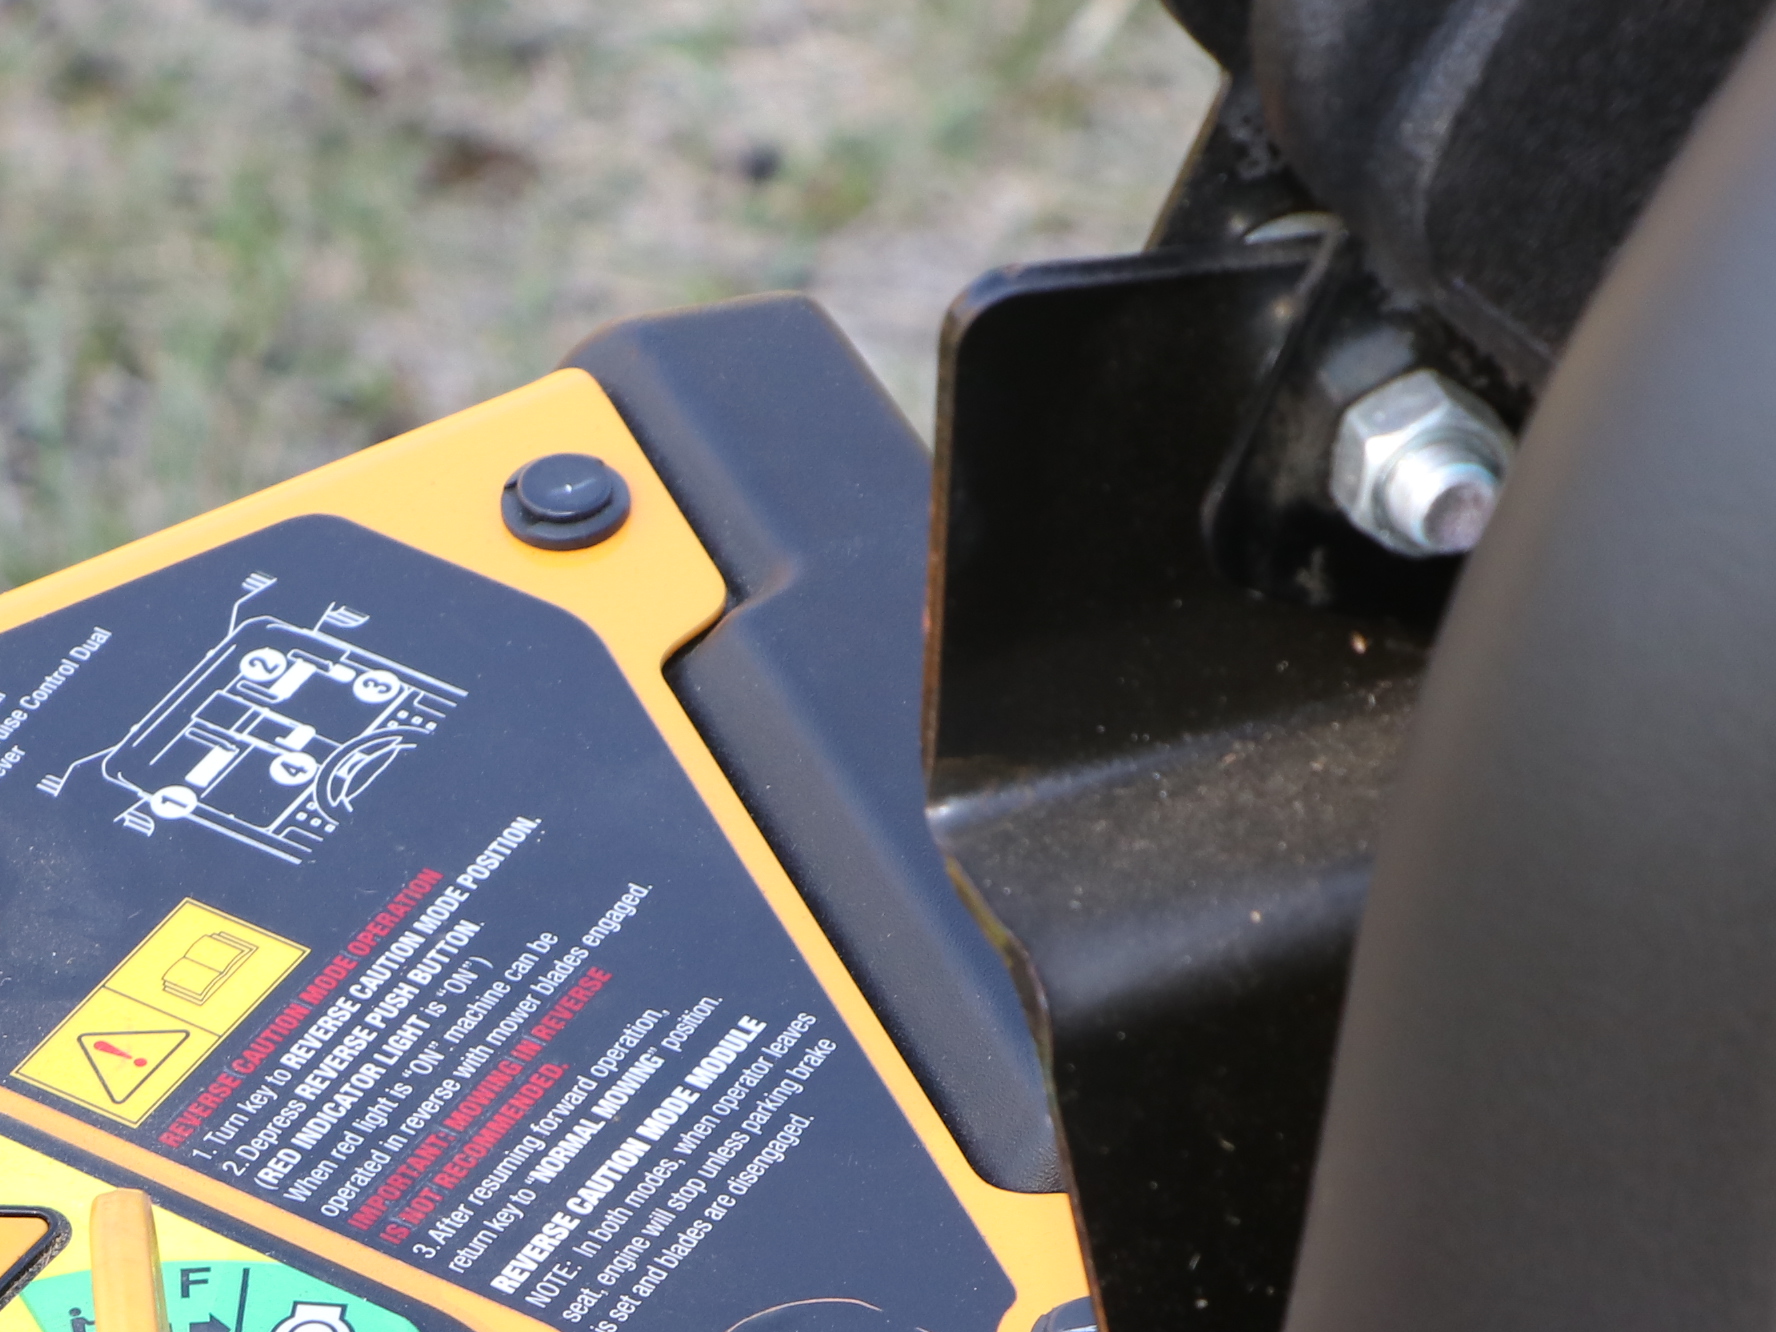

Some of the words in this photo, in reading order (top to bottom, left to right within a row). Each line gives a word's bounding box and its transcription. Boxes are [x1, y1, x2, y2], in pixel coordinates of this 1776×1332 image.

[18, 657, 81, 712] Control
[68, 625, 113, 663] Dual
[157, 1072, 243, 1149] REVERSE
[230, 1002, 312, 1075] CAUTION
[298, 954, 359, 1006] MODE
[346, 867, 444, 957] OPERATION
[201, 1112, 251, 1146] Turn
[235, 1083, 279, 1115] key
[263, 1067, 293, 1087] to
[278, 995, 363, 1071] REVERSE
[348, 930, 427, 1000] CAUTION
[411, 885, 471, 936] MODE
[455, 815, 543, 891] POSITION.
[281, 1159, 340, 1203] When
[329, 1129, 366, 1161] red
[350, 1096, 400, 1134] light
[383, 1081, 414, 1100] is
[442, 980, 512, 1045] machine
[503, 951, 541, 982] can
[525, 931, 559, 955] be
[293, 1024, 379, 1102] REVERSE
[363, 981, 421, 1030] PUSH
[405, 918, 486, 986] BUTTON.
[319, 1147, 393, 1218] operated
[377, 1133, 409, 1153] in
[398, 1077, 462, 1136] reverse
[451, 1043, 495, 1080] with
[484, 992, 542, 1047] mower
[528, 945, 590, 997] blades
[580, 881, 654, 948] engaged.
[760, 1011, 818, 1059] leaves
[252, 1147, 303, 1191] (RED
[289, 1061, 388, 1151] INDICATOR
[372, 1013, 432, 1067] LIGHT
[418, 1000, 448, 1019] is
[347, 1130, 456, 1231] IMPORTANT:
[442, 1059, 524, 1132] MOWING
[510, 1038, 543, 1062] IN
[529, 966, 613, 1042] REVERSE
[378, 1222, 411, 1246] IS
[397, 1186, 444, 1226] NOT
[432, 1062, 570, 1190] RECOMMENDED.
[447, 1228, 499, 1275] return
[482, 1201, 525, 1233] key
[508, 1187, 538, 1206] to
[659, 996, 724, 1053] position.
[466, 1134, 548, 1207] resuming
[528, 1074, 599, 1137] forward
[589, 1008, 671, 1079] operation,
[489, 1210, 582, 1295] REVERSE
[565, 1136, 652, 1216] CAUTION
[634, 1084, 702, 1142] MODE
[683, 1014, 768, 1091] MODULE
[672, 1114, 722, 1156] when
[711, 1054, 775, 1117] operator
[561, 1286, 610, 1324] seat,
[596, 1235, 652, 1287] engine
[640, 1206, 677, 1238] will
[666, 1177, 709, 1212] stop
[696, 1130, 752, 1180] unless
[740, 1077, 805, 1136] parking
[784, 1037, 838, 1081] brake
[571, 1239, 603, 1259] In
[586, 1206, 635, 1243] both
[608, 1294, 643, 1323] set
[631, 1263, 669, 1298] and
[652, 1218, 714, 1270] blades
[703, 1193, 737, 1222] are
[726, 1112, 816, 1196] disengaged.
[623, 1157, 687, 1209] modes,
[180, 1266, 211, 1299] F
[523, 1260, 583, 1309] NOTE:
